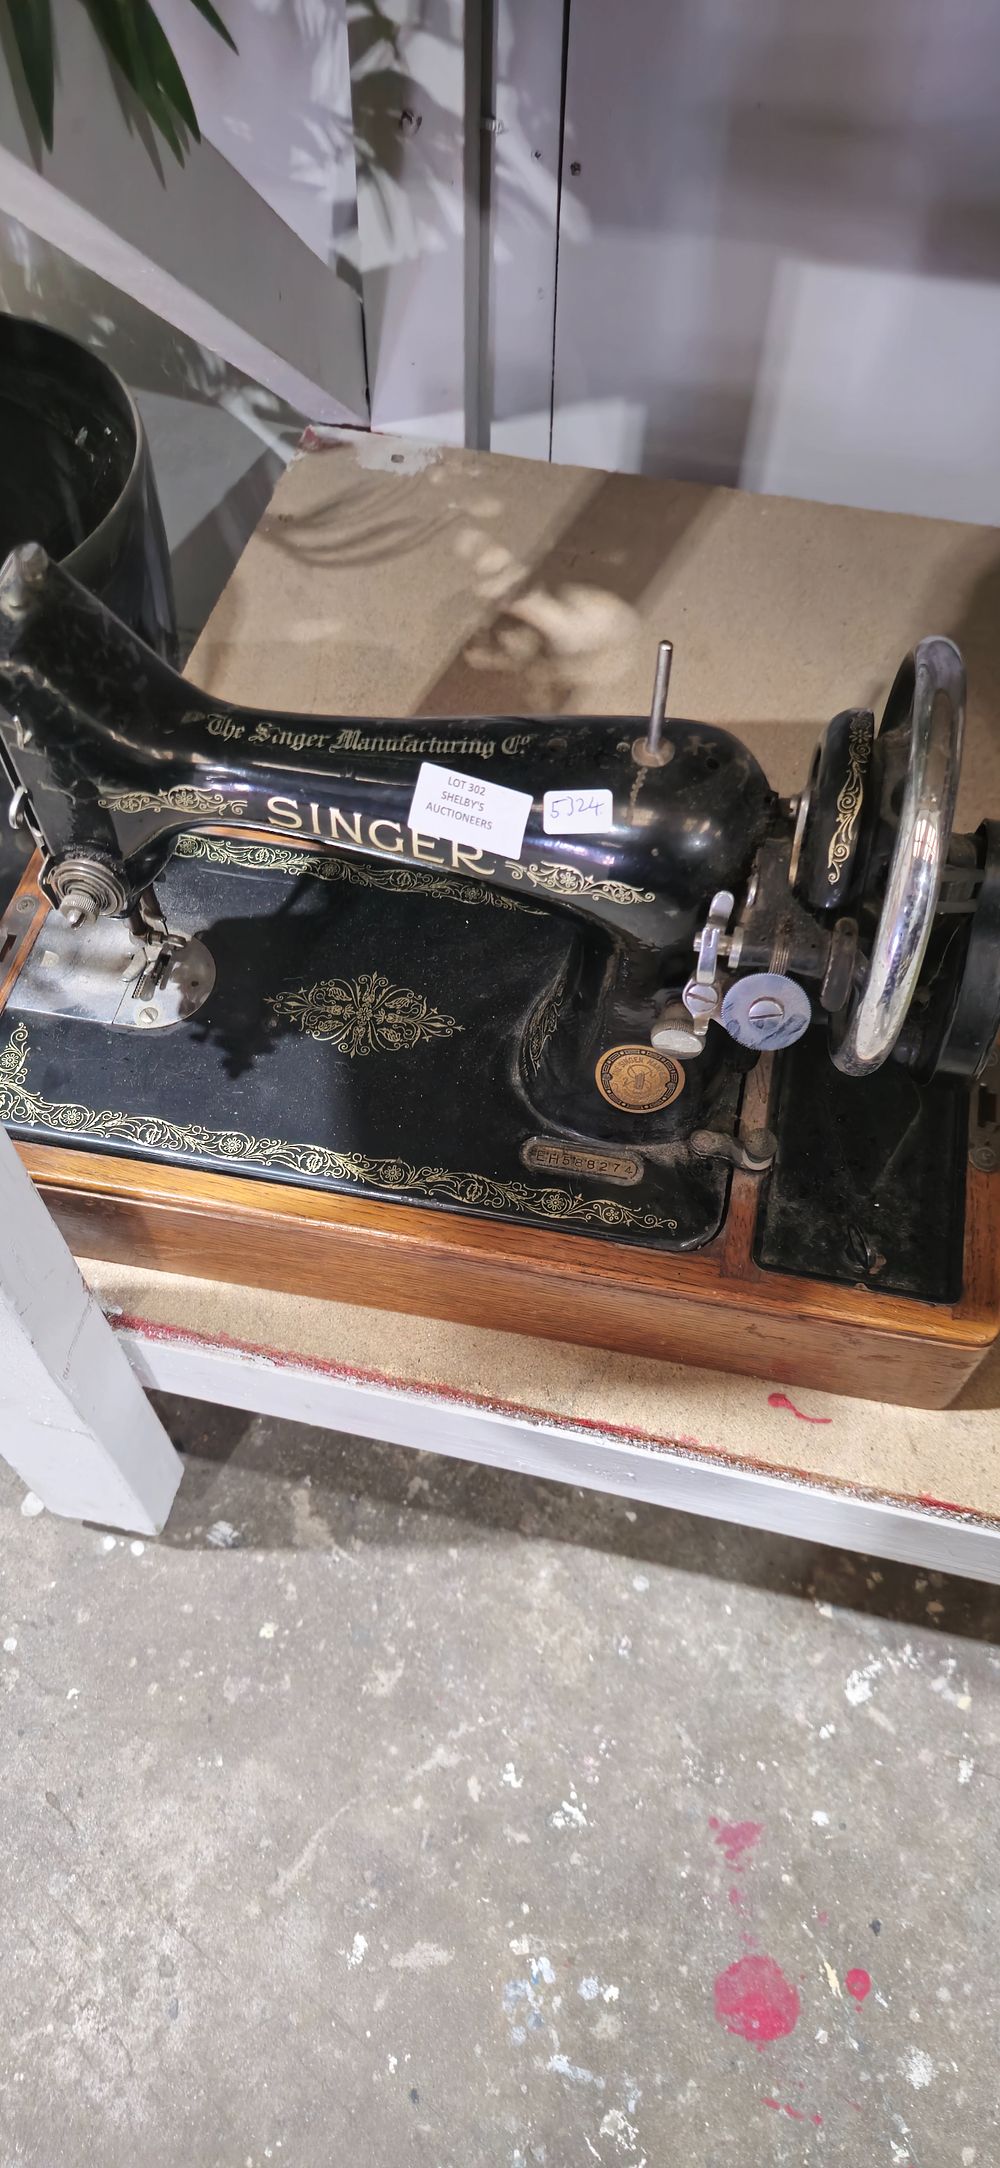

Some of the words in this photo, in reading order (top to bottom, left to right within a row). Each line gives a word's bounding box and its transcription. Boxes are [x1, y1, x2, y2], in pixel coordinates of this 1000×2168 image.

[207, 713, 245, 741] The
[248, 722, 330, 751] Singer
[329, 729, 496, 759] Manufacturing
[447, 777, 467, 790] LOT
[469, 783, 486, 796] 302
[441, 790, 485, 812] SHELBY'S
[425, 802, 493, 830] AUCTIONEERS
[267, 796, 495, 875] SINGER
[536, 1150, 633, 1174] EH588274
